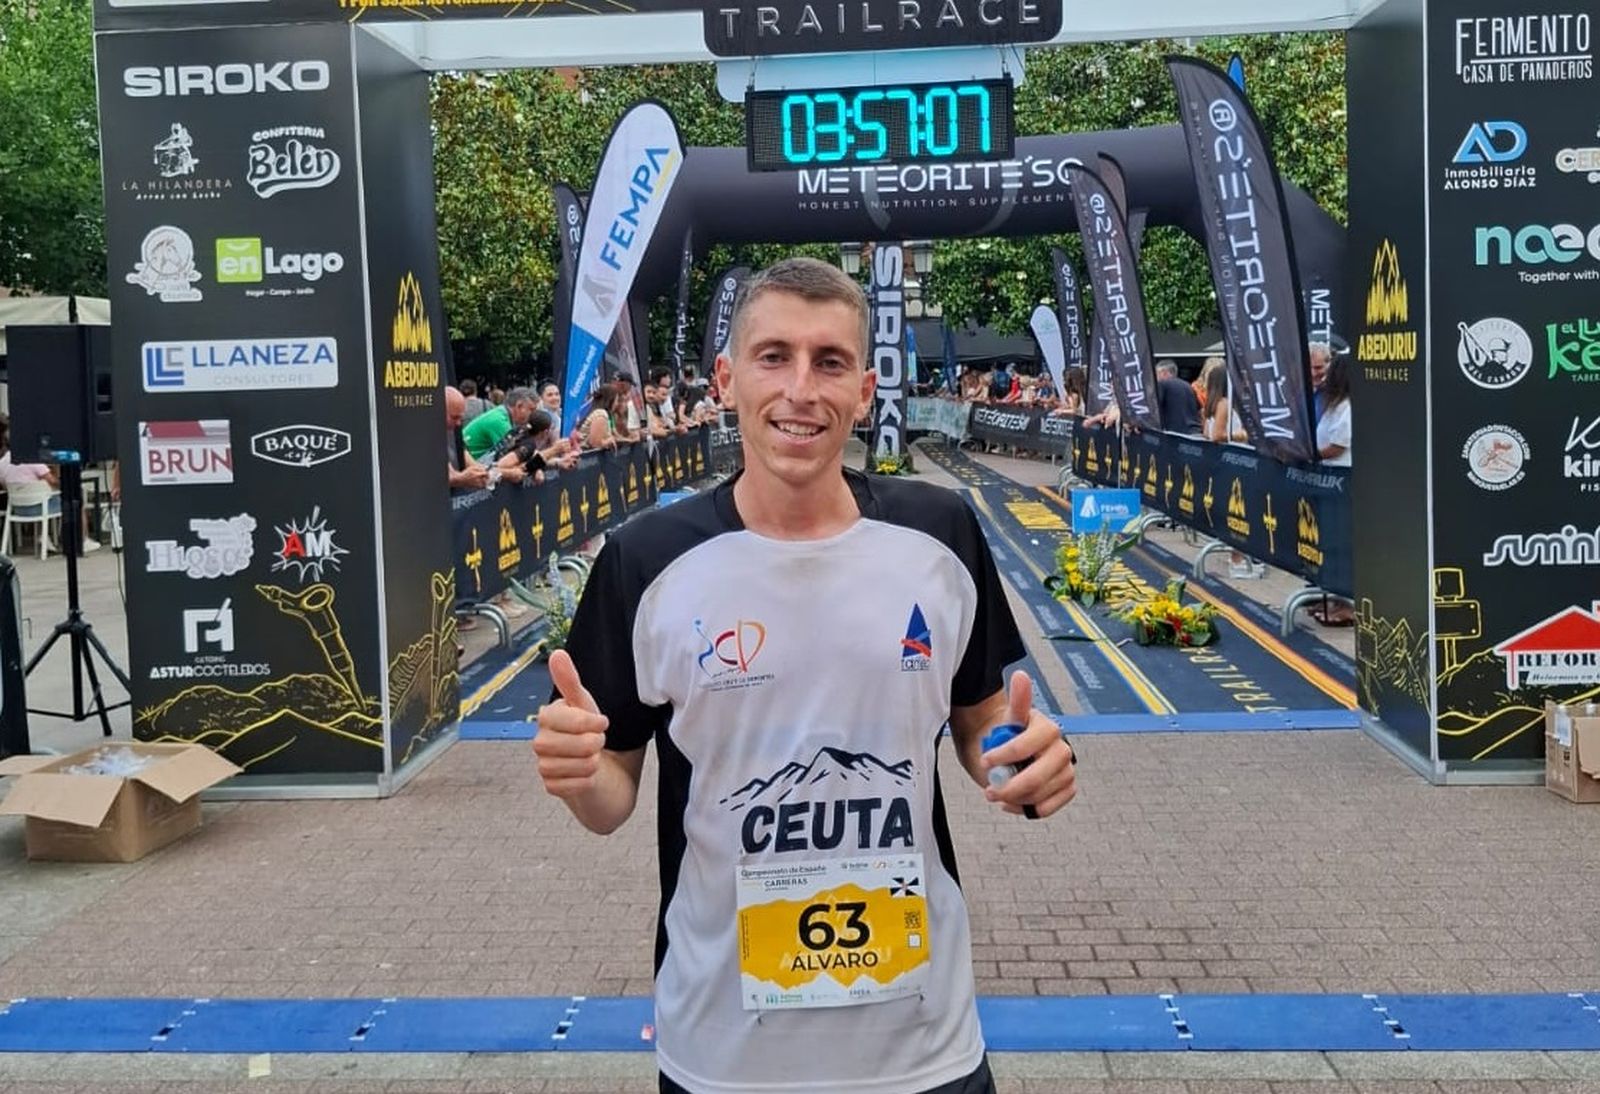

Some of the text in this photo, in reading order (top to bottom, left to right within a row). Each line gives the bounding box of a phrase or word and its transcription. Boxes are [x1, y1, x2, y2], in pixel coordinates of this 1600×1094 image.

[719, 0, 1041, 38] TRAILRACE
[1456, 14, 1590, 75] FERMENTO
[123, 60, 330, 97] SIROKO
[1463, 60, 1593, 84] CASA DE PANADEROS
[252, 126, 325, 142] CONFITERIA
[781, 85, 992, 163] 03:57:07
[122, 179, 233, 191] LA HILANDERA
[1444, 178, 1499, 190] ALONSO
[1445, 167, 1536, 179] inmobiliaria
[600, 147, 670, 271] FEMPA
[799, 201, 859, 210] HONEST
[871, 199, 957, 209] NUTRITION
[1518, 270, 1600, 283] Together with
[192, 343, 334, 367] LLANEZA
[1358, 331, 1418, 361] ABEDURIU
[213, 372, 314, 386] CONSULTORES
[384, 360, 440, 389] ABEDURIU
[1364, 367, 1409, 381] TRAILRACE
[393, 393, 434, 407] TRAILRACE
[264, 433, 338, 451] BAQUÉ
[148, 447, 233, 475] BRUN
[283, 530, 332, 559] AM
[741, 796, 915, 854] CEUTA
[764, 878, 808, 887] CARRERAS
[798, 901, 871, 951] 63
